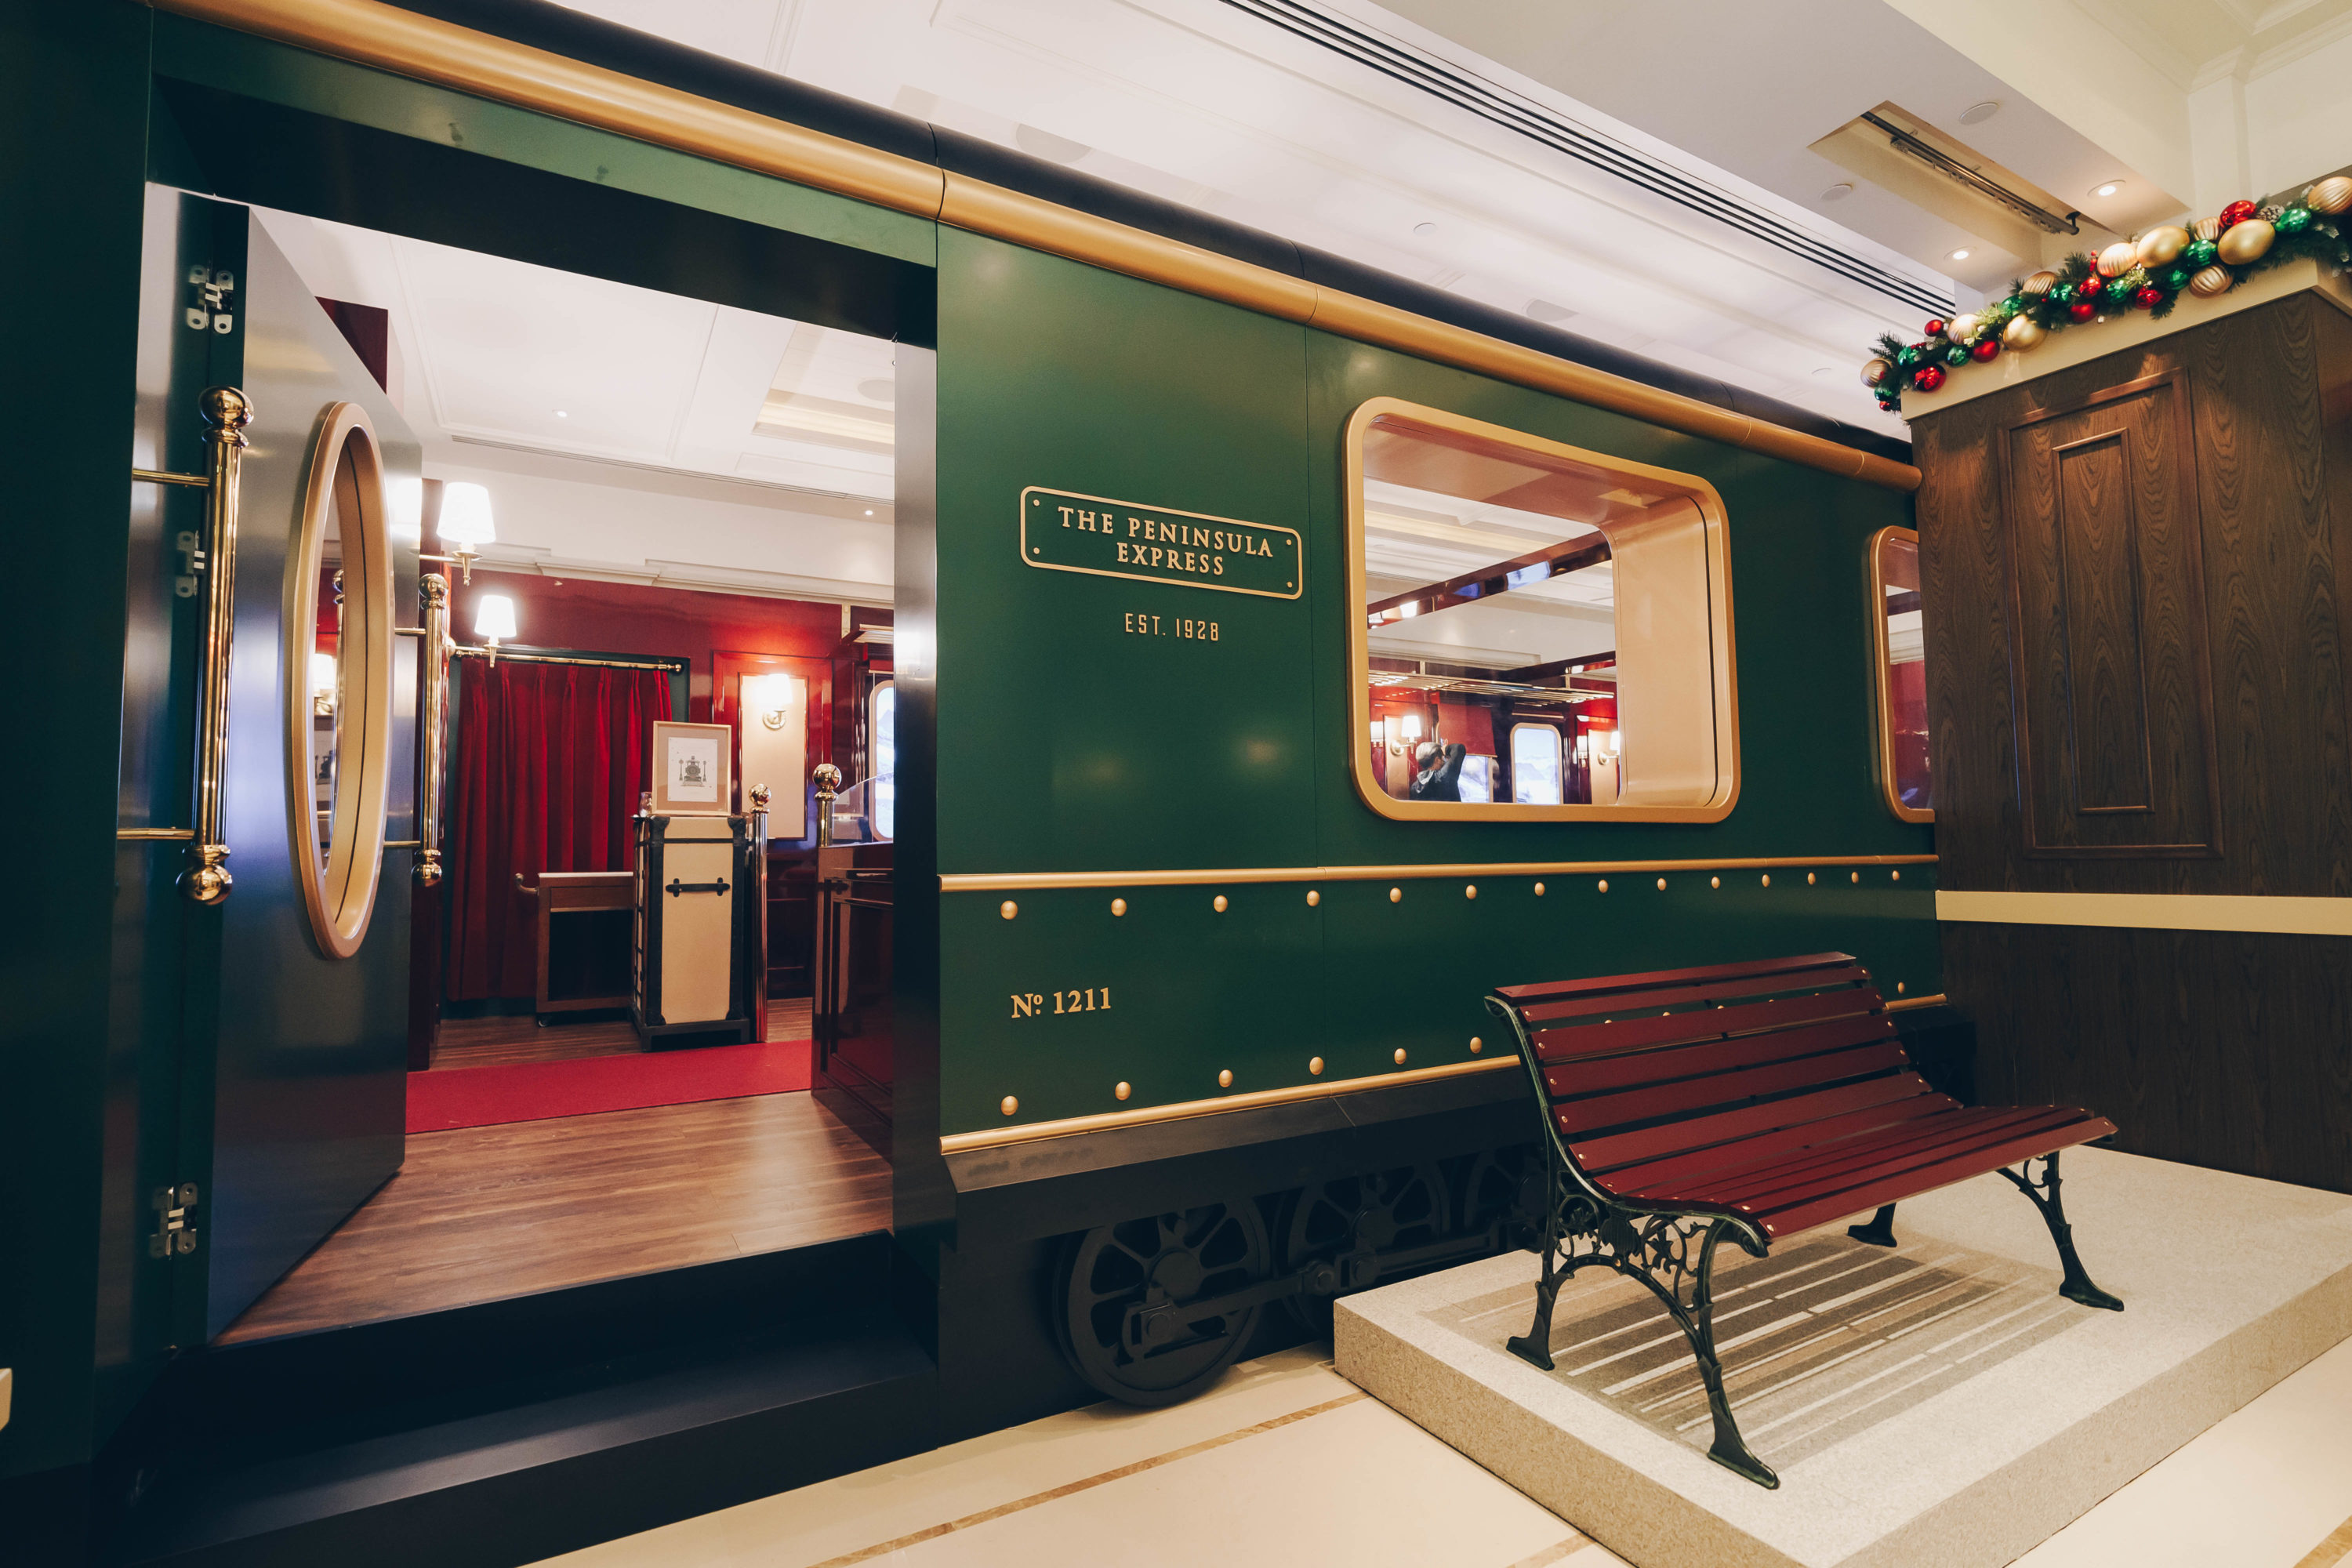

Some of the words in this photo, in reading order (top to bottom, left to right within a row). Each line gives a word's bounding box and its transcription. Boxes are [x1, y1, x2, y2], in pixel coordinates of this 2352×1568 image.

[1058, 506, 1113, 535] THE
[1127, 517, 1274, 557] PENINSULA
[1116, 542, 1224, 575] EXPRESS
[1125, 612, 1166, 636] EST.
[1176, 618, 1219, 641] 1928
[1053, 987, 1112, 1014] 1211
